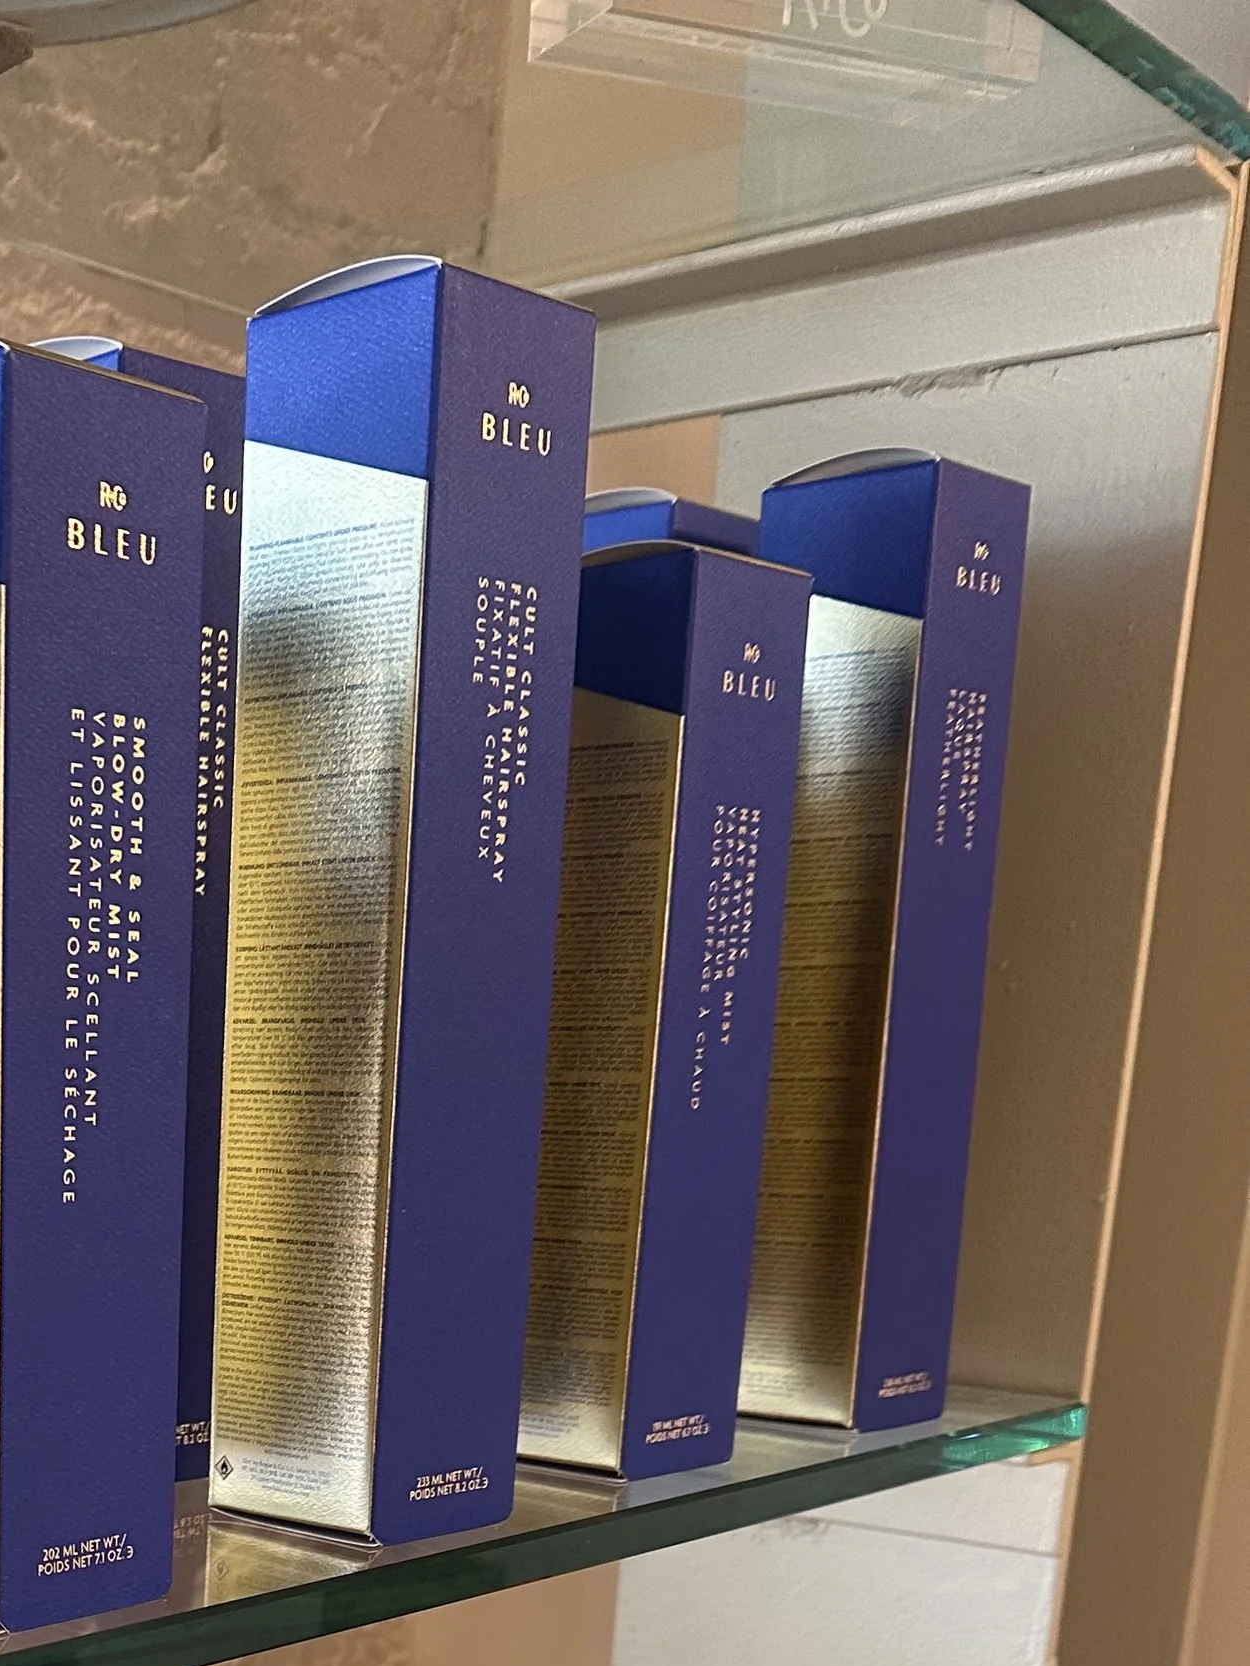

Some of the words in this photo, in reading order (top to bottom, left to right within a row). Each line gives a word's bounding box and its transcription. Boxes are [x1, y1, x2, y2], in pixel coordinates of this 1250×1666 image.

[482, 412, 552, 456] BLEU
[205, 484, 237, 515] EU
[67, 517, 157, 565] BLEU
[956, 565, 1001, 596] BLEU
[472, 576, 489, 684] SOUPLE
[488, 579, 506, 687] FIXATIF
[502, 582, 521, 712] FLEXIBLE
[521, 586, 538, 655] CULT
[198, 626, 213, 742] FLEXIBLE
[216, 629, 229, 691] CULT
[722, 669, 776, 702] BLEU
[70, 708, 85, 742] ET
[486, 701, 503, 719] À
[514, 670, 533, 786] CLASSIC
[129, 716, 147, 855] SMOOTH
[213, 704, 227, 808] CLASSIC
[67, 762, 84, 897] LISSANT
[86, 710, 105, 955] VAPORISATEUR
[108, 713, 126, 884] BLOW-DRY
[194, 756, 210, 895] HAIRSPRAY
[477, 734, 497, 859] CHEVEUX
[493, 727, 513, 882] HAIRSPRAY
[710, 805, 725, 867] POUR
[734, 808, 749, 865] HEAT
[128, 873, 142, 891] &
[713, 806, 737, 981] VAPORISATEUR
[739, 809, 761, 958] HYPERSONIC
[65, 916, 81, 1001] POUR
[107, 904, 122, 979] MIST
[125, 910, 141, 984] SEAL
[699, 880, 719, 992] COIFFAGE
[725, 879, 743, 978] STYLING
[64, 1019, 79, 1050] LE
[84, 973, 101, 1126] SCELLANT
[697, 1005, 712, 1018] À
[720, 991, 734, 1044] MIST
[690, 1031, 706, 1109] CHAUD
[62, 1067, 78, 1204] SÉCHAGE
[409, 1488, 436, 1501] POIDS
[436, 1484, 454, 1497] NET
[445, 1469, 463, 1484] NET
[37, 1559, 70, 1576] POIDS
[72, 1554, 93, 1569] NET
[42, 1546, 61, 1561] 202
[62, 1543, 79, 1557] ML
[80, 1538, 101, 1553] NET
